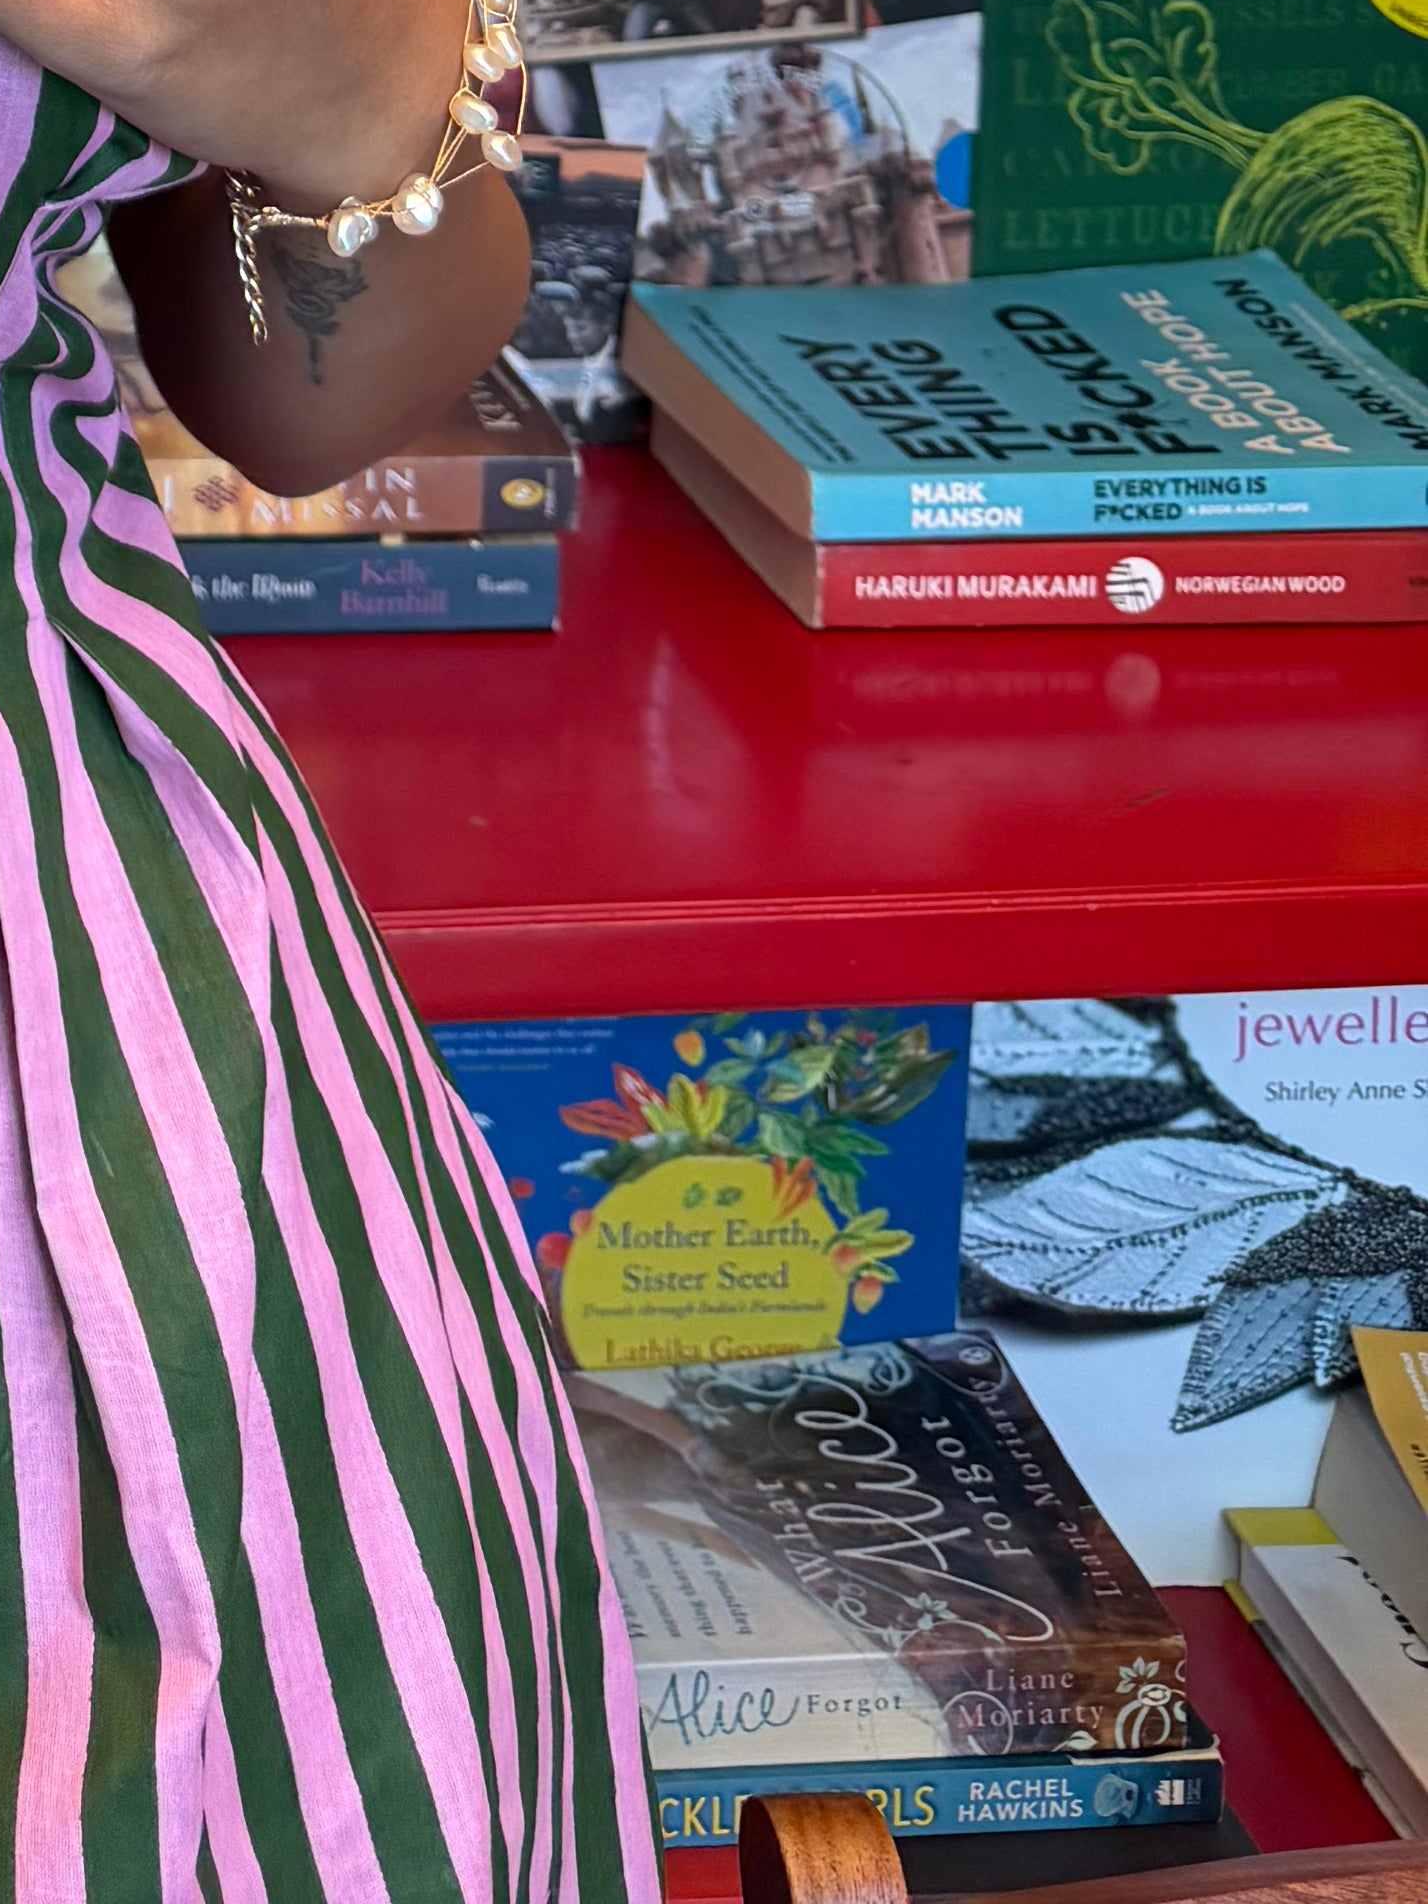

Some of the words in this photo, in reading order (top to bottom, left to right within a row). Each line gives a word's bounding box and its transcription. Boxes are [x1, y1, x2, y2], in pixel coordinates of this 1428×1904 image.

[1120, 288, 1232, 363] HOPE
[1213, 277, 1360, 382] MANSON
[778, 332, 976, 462] EVERY
[870, 337, 1053, 462] THING
[1139, 355, 1263, 431] BOOK
[1205, 366, 1353, 455] ABOUT
[1045, 420, 1139, 458] IS
[1242, 433, 1297, 457] A
[909, 480, 988, 506] MARK
[1093, 476, 1242, 500] EVERYTHING
[1245, 476, 1267, 496] IS
[250, 494, 425, 527] MISSAL
[909, 505, 1024, 530] MANSON
[360, 557, 431, 587] Kelly
[855, 575, 954, 600] HARUKI
[956, 574, 1098, 599] MURAKAMI
[1175, 575, 1287, 595] NORWEGIAN
[1288, 575, 1346, 594] WOOD
[340, 586, 451, 616] Barnhill
[1264, 1079, 1341, 1107] Shirley
[1346, 1079, 1407, 1101] Anne
[597, 1220, 717, 1250] Mother
[724, 1217, 820, 1249] Earth,
[621, 1262, 710, 1294] Sister
[715, 1260, 791, 1291] Seed
[604, 1337, 703, 1365] Lathika
[968, 1375, 1065, 1510] Moriarty
[921, 1416, 1036, 1560] Forgot
[793, 1372, 1056, 1642] Alice
[755, 1479, 834, 1584] What
[1055, 1520, 1124, 1599] Liane
[986, 1668, 1076, 1694] Liane
[646, 1669, 800, 1747] Alice
[805, 1693, 904, 1715] Forgot
[957, 1700, 1106, 1733] Moriarty
[968, 1778, 1076, 1801] RACHEL
[957, 1798, 1085, 1823] HAWKINS
